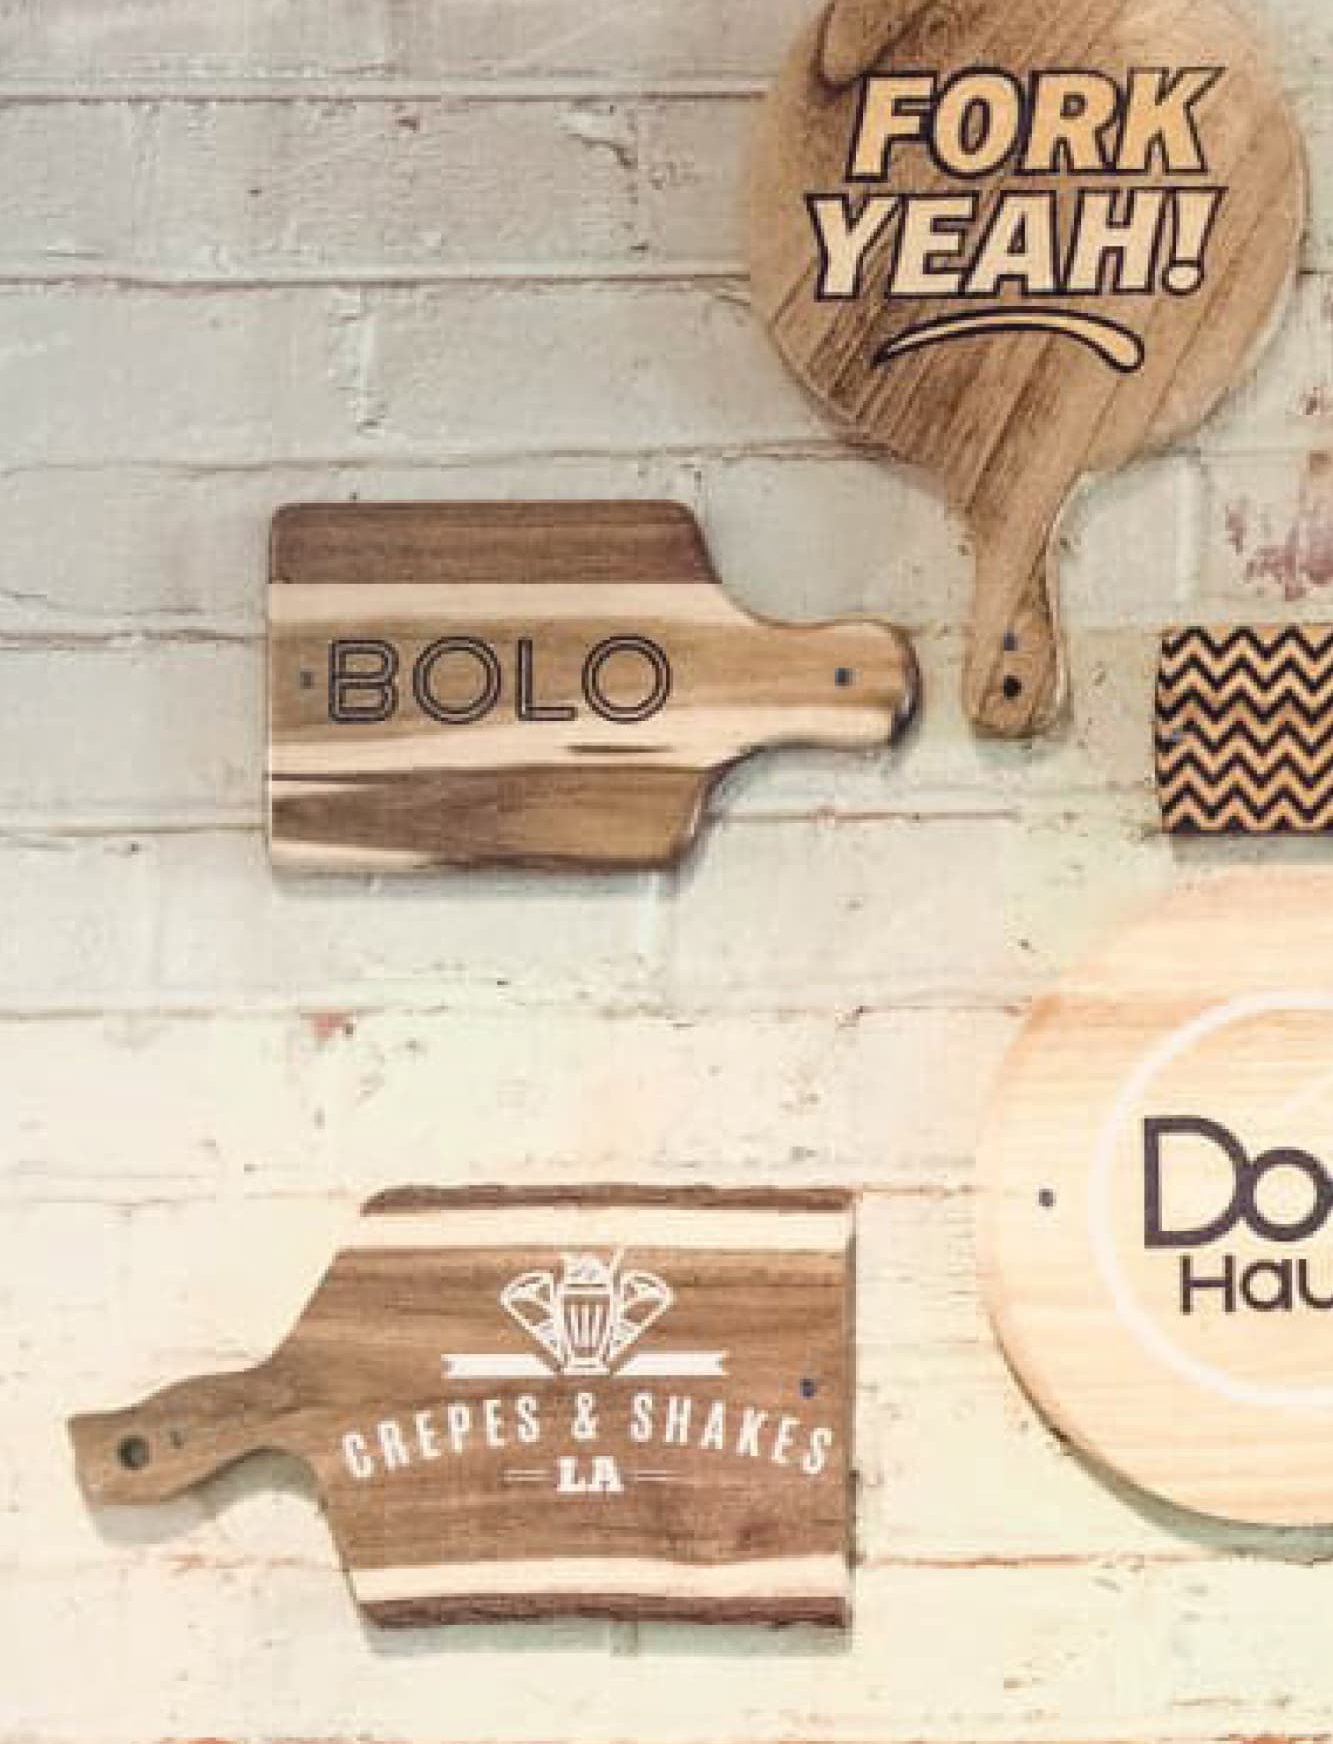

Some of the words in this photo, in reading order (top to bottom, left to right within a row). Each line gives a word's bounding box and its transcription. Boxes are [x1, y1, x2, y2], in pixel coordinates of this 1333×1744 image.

[844, 65, 1228, 183] FORK
[804, 185, 1230, 302] YEAH!
[326, 635, 674, 724] BOLO
[341, 1393, 541, 1479] CREPES
[571, 1392, 598, 1441] &
[630, 1392, 833, 1475] SHAKES
[556, 1456, 625, 1493] LA
